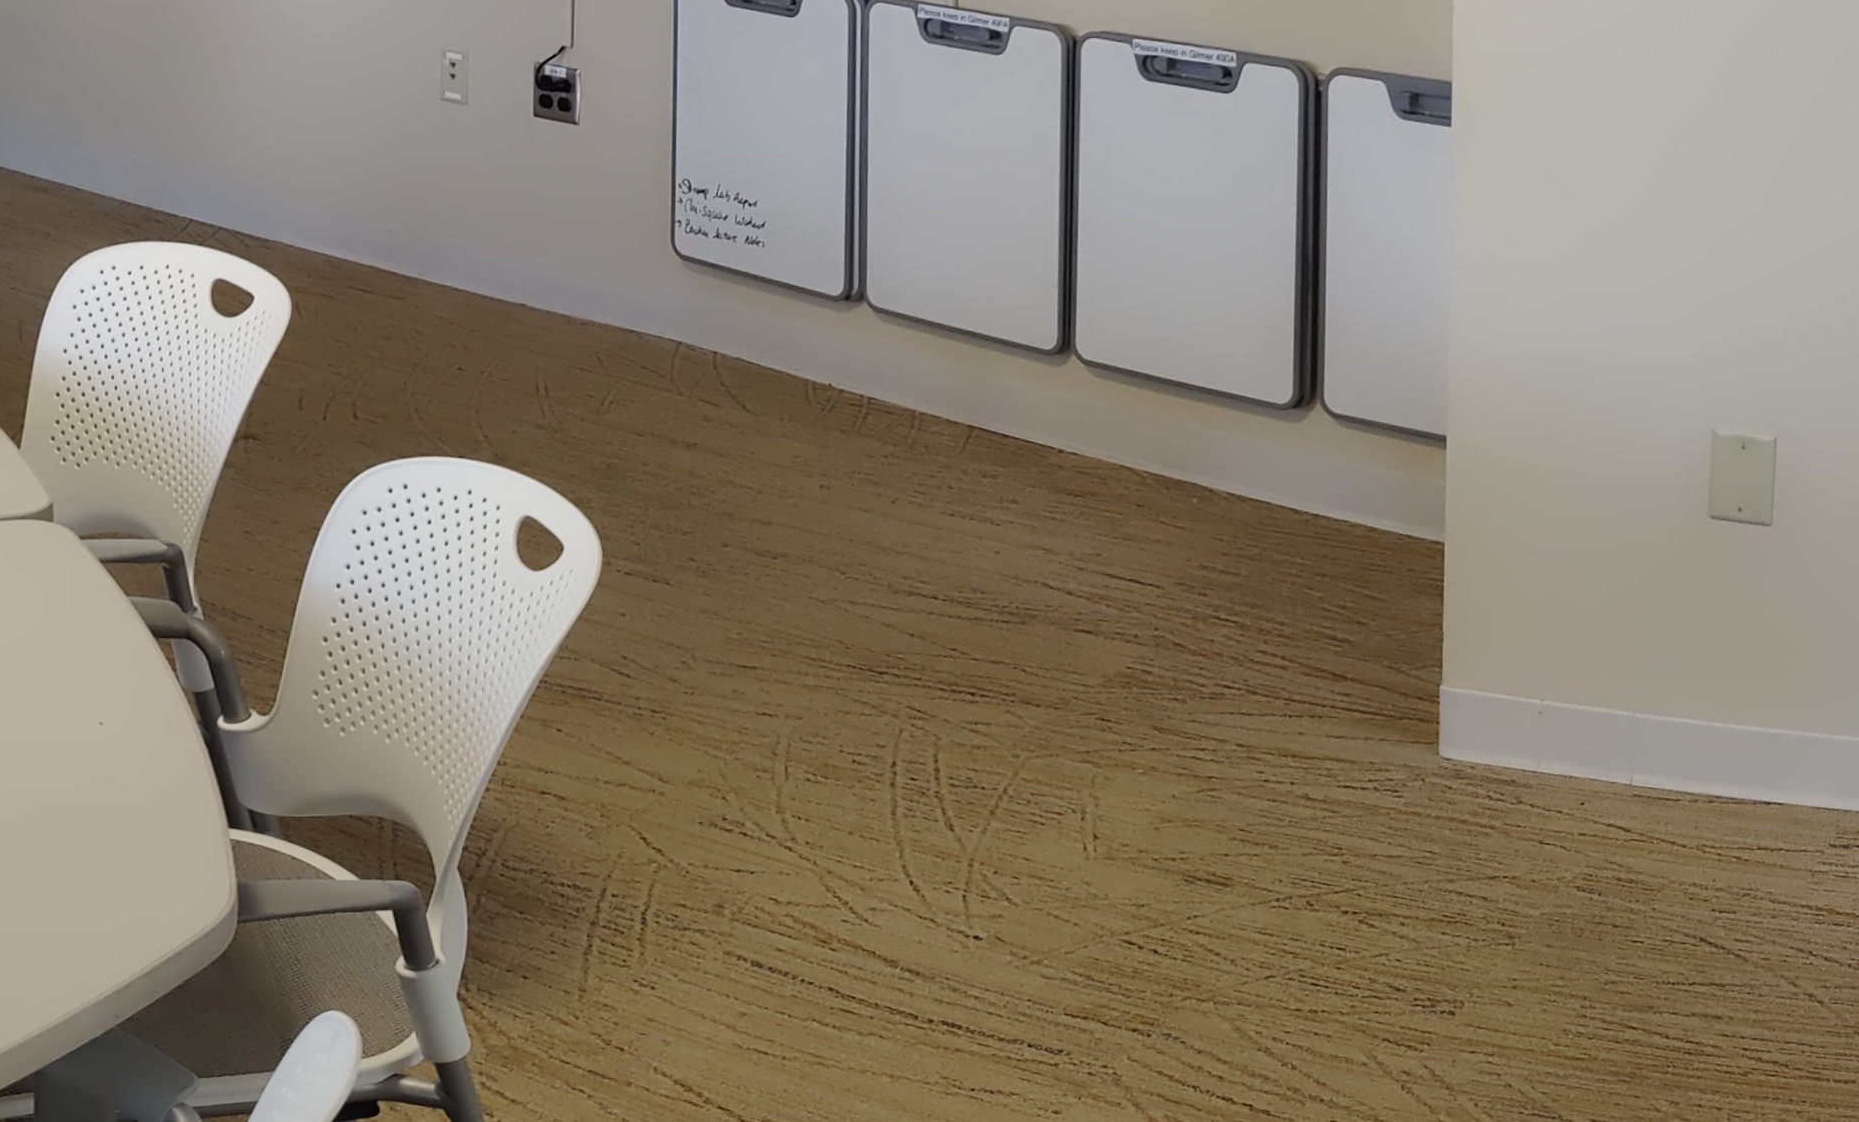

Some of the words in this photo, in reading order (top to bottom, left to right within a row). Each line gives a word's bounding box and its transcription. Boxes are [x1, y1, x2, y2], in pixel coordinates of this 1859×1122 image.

[1134, 42, 1158, 52] Please
[1161, 45, 1178, 56] keep
[1189, 50, 1213, 60] Gilmer
